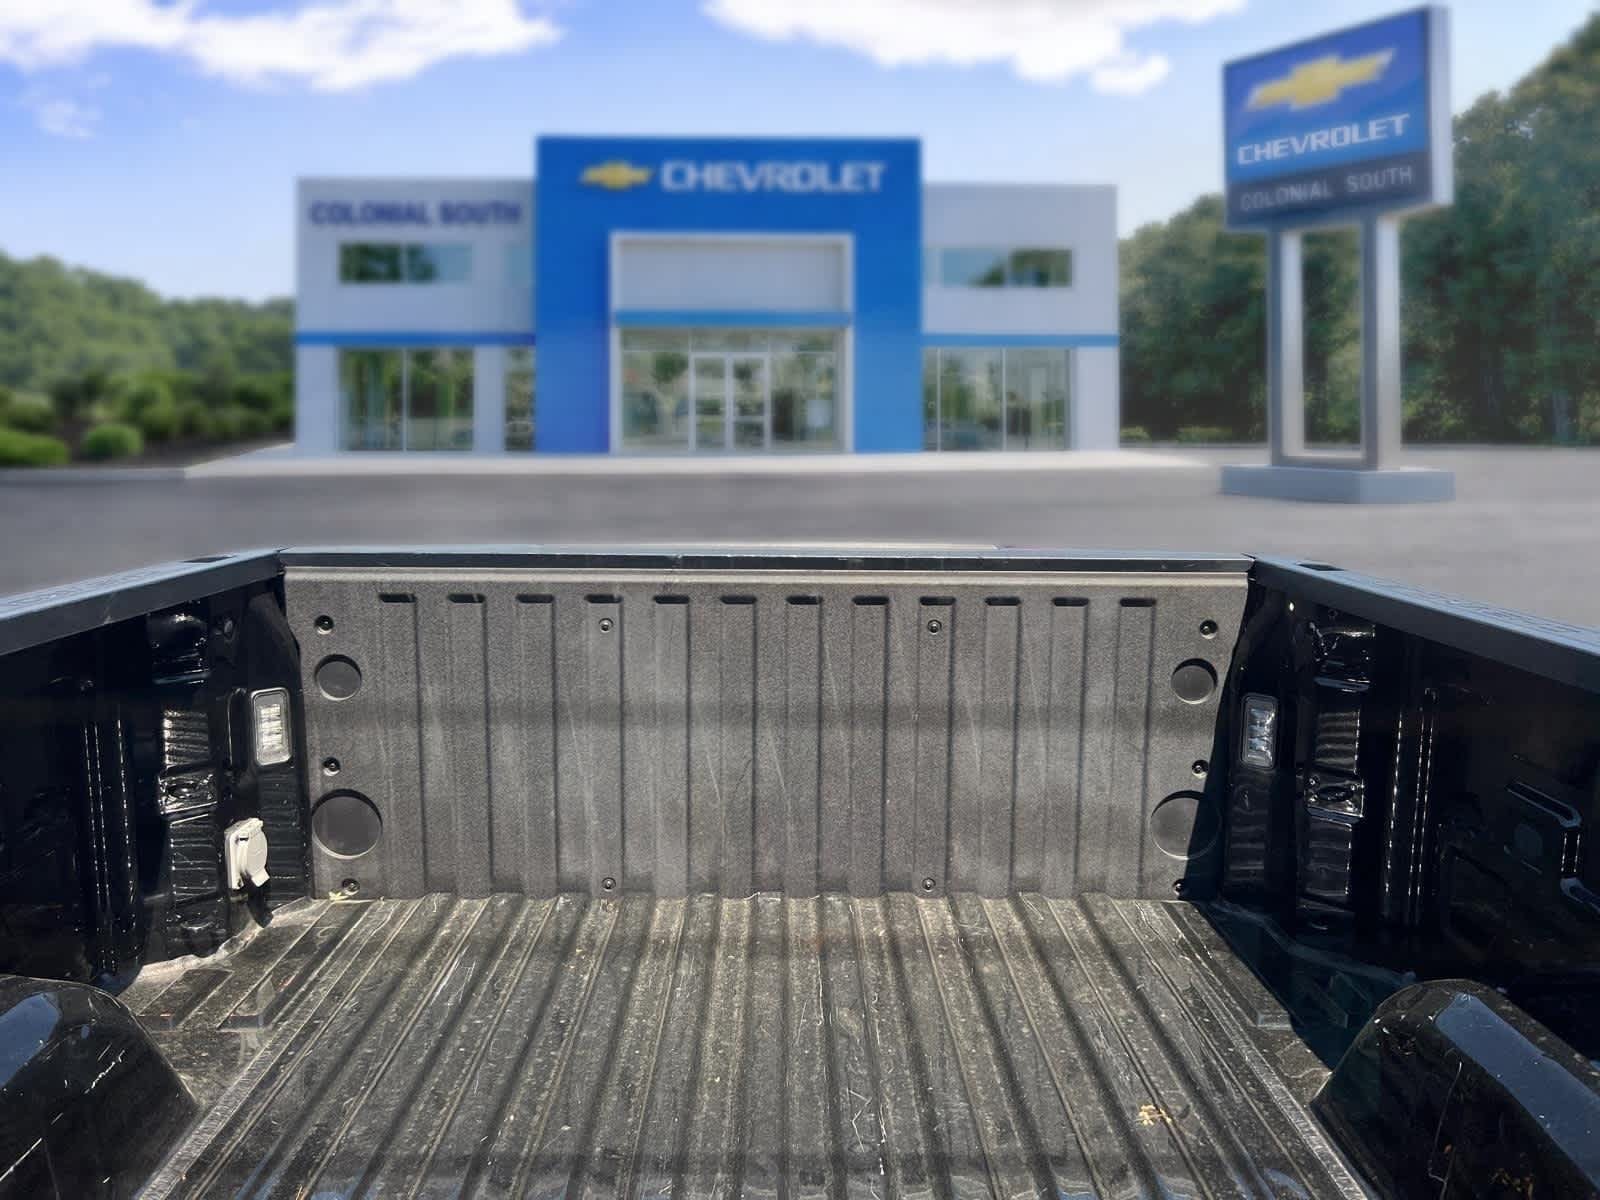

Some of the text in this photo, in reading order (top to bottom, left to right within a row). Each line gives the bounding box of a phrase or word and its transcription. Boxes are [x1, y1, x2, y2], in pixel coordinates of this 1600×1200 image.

[1237, 113, 1409, 164] CHEVROLET
[661, 161, 885, 193] CHEVROLET
[1241, 165, 1412, 211] COLONIAL SOUTH
[310, 202, 521, 225] COLONIAL SOUTH
